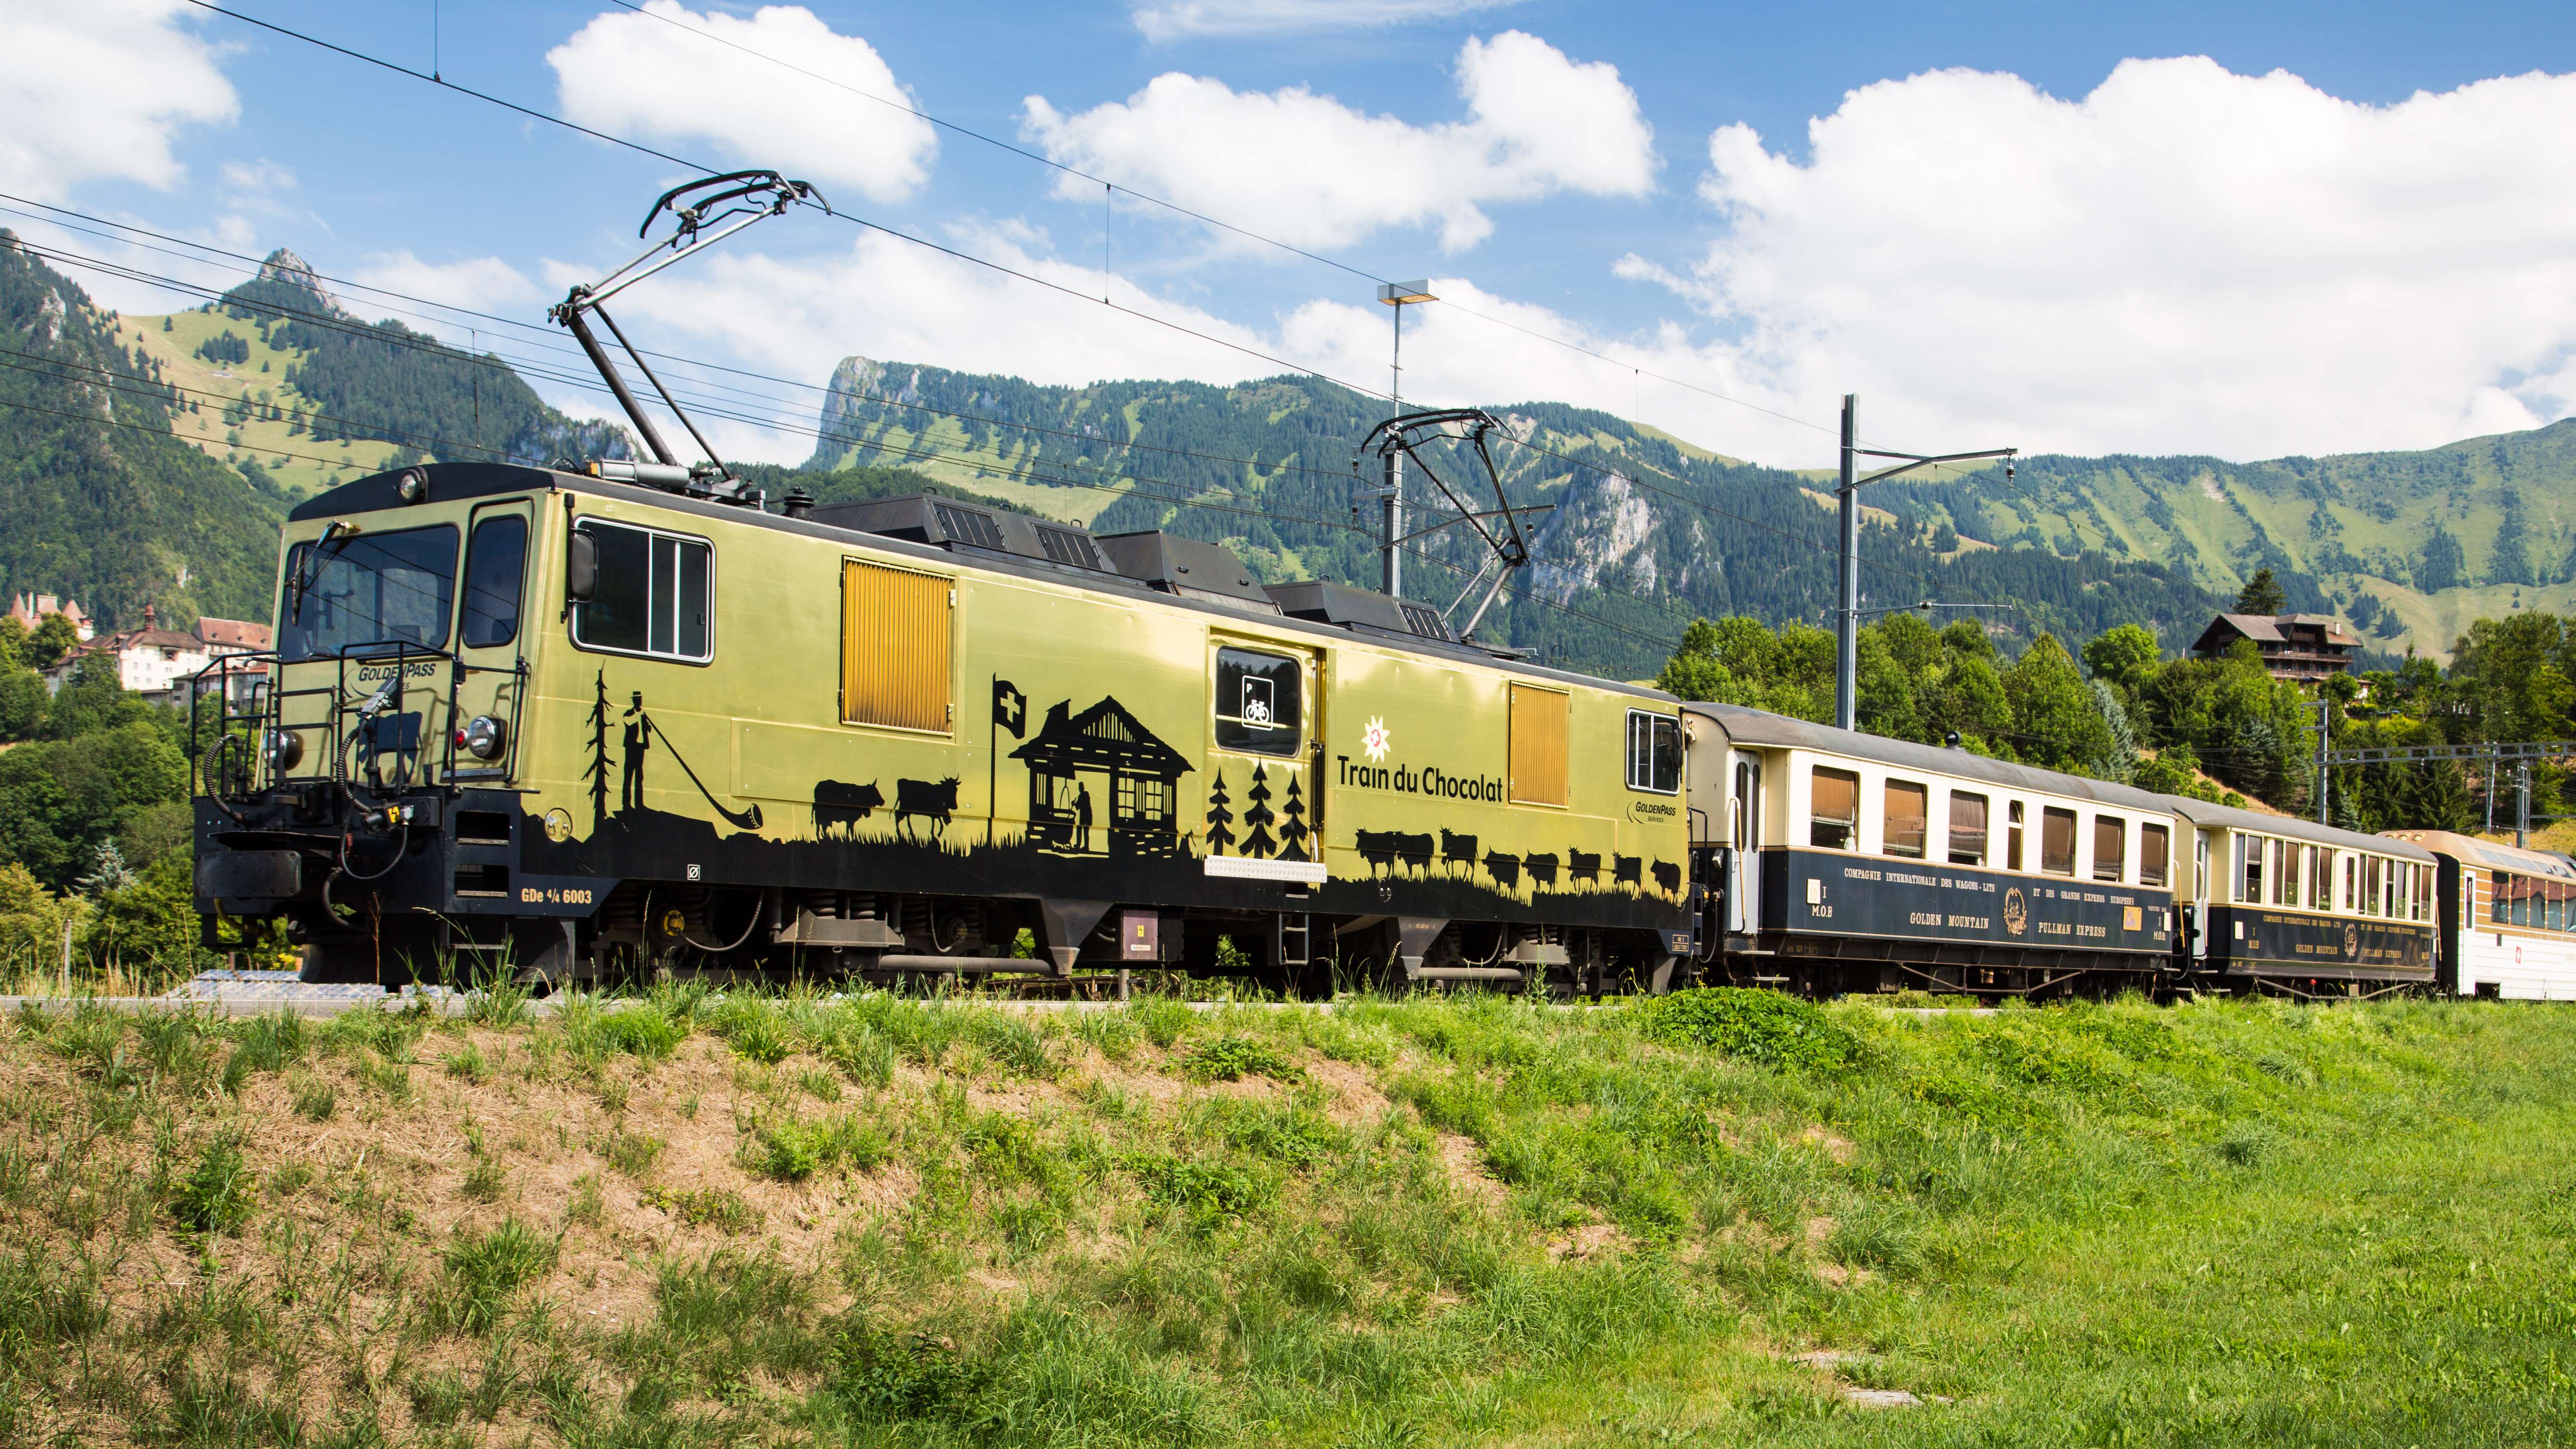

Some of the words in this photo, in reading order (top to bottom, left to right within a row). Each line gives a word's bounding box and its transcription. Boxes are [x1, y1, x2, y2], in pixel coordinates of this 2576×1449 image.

[358, 663, 437, 681] GOLDEPASS
[1246, 683, 1252, 693] P
[1337, 755, 1389, 790] Train
[1394, 763, 1418, 793] du
[1422, 767, 1503, 803] Chocolat
[1844, 867, 1881, 881] COMPAGNIE
[1886, 872, 1936, 886] INTERNATIONALE
[1940, 878, 1952, 888] DES
[2033, 888, 2041, 897] ET
[2045, 889, 2055, 898] DES
[2061, 890, 2080, 900] GRANDS
[2083, 893, 2105, 903] EXPRESS
[2468, 880, 2471, 895] 1
[521, 888, 544, 902] GDe
[563, 889, 592, 904] 6003
[1910, 912, 1942, 926] GOLDEN
[1948, 915, 1989, 929] MOUNTAIN
[2038, 922, 2072, 935] PULLMAN
[2076, 925, 2106, 937] EXPRESS
[2296, 944, 2313, 954] GOLDEN
[2317, 945, 2338, 954] MOUNTAIN
[2364, 948, 2383, 957] PULLMAN
